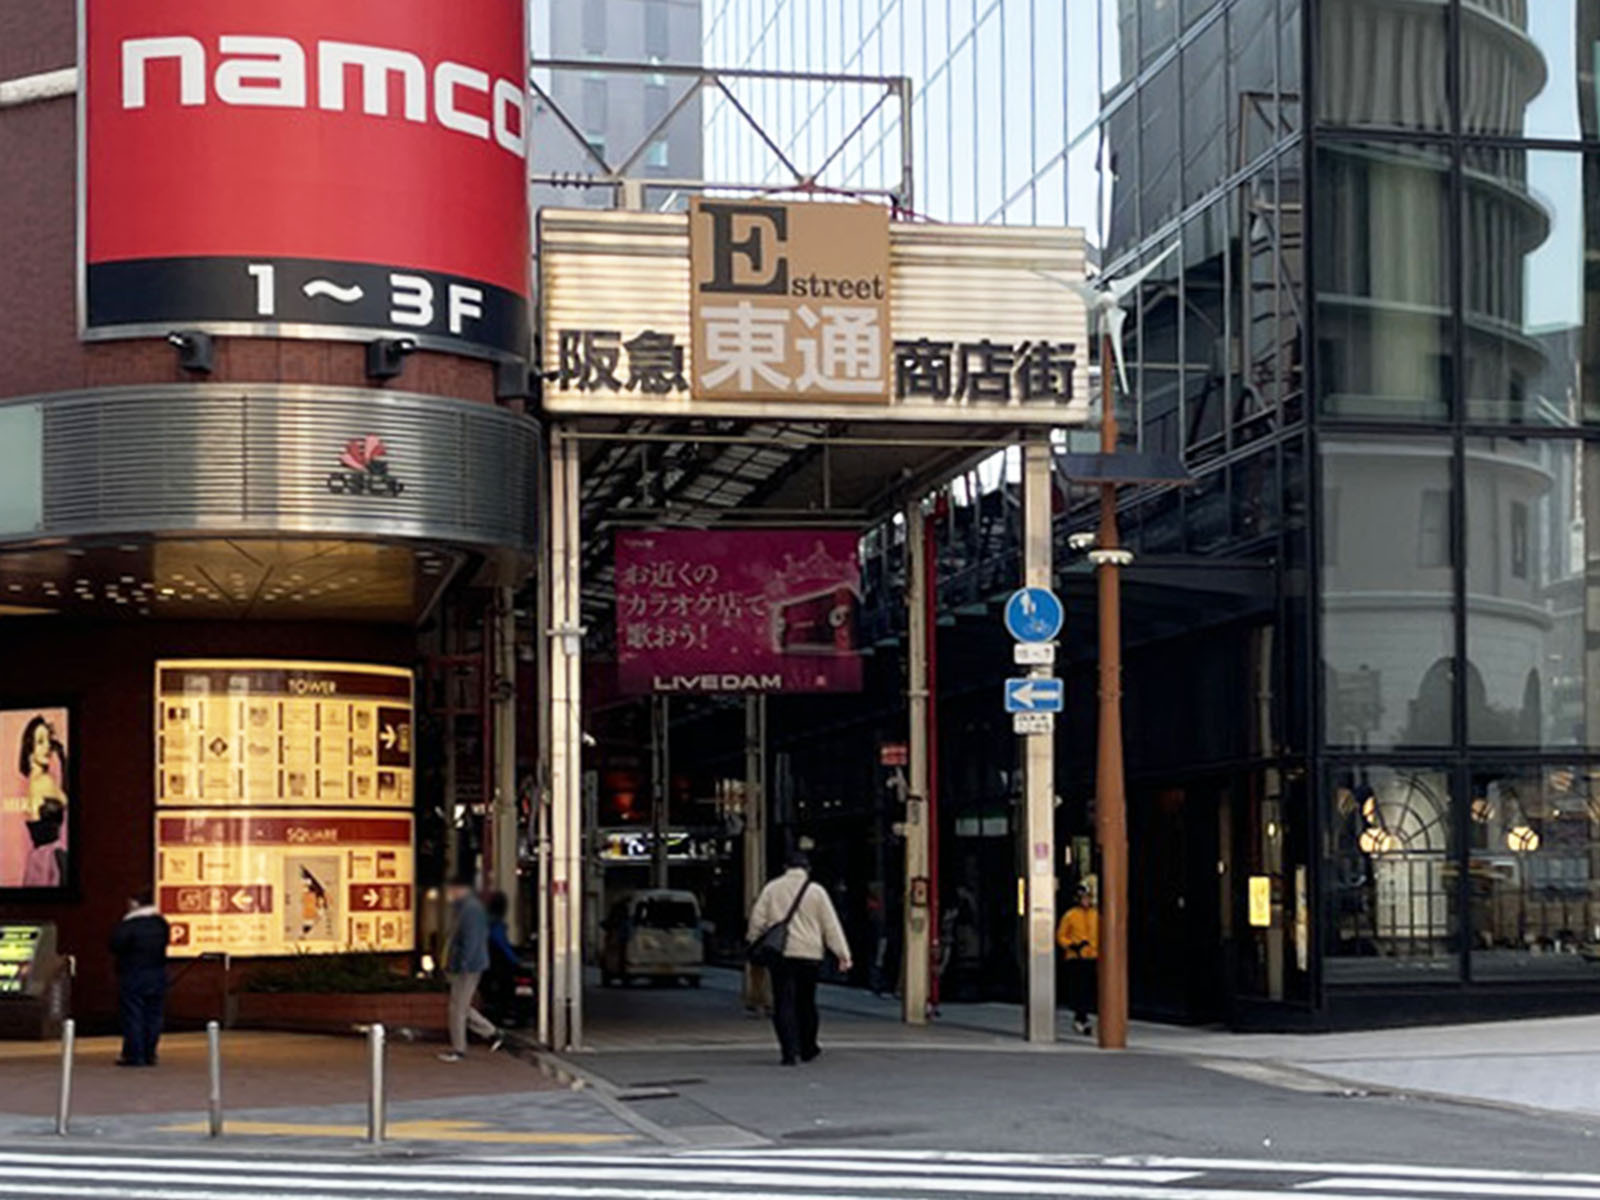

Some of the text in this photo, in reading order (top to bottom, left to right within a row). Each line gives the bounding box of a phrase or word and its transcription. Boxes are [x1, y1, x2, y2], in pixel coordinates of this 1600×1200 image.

[122, 36, 525, 158] namco
[699, 204, 884, 299] E street
[701, 302, 882, 393] 東通
[895, 337, 1077, 406] 商店街
[625, 560, 719, 589] お近くの
[287, 679, 336, 694] TOWER
[286, 827, 338, 844] SQUARE
